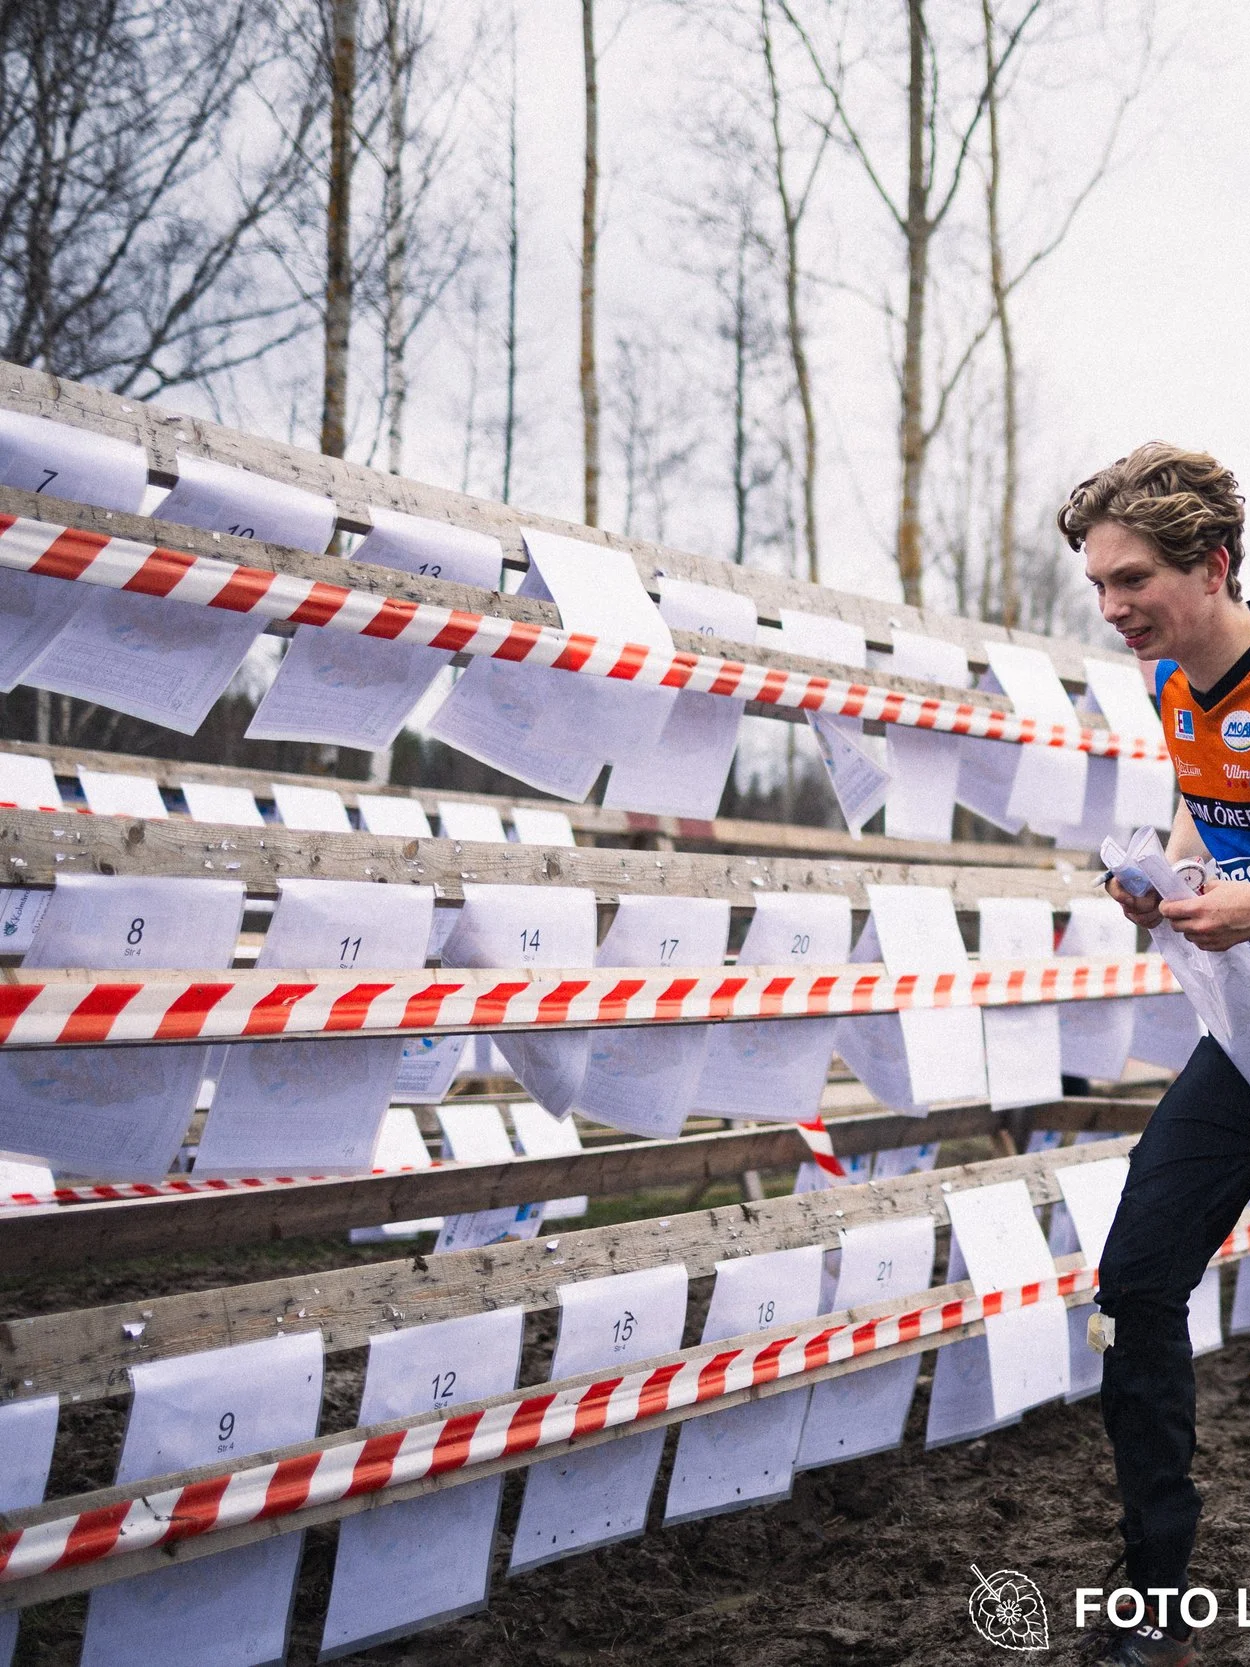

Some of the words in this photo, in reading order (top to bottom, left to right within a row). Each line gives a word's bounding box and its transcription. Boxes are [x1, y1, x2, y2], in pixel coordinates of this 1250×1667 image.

[36, 468, 59, 493] 7
[126, 917, 145, 945] 8
[520, 928, 541, 952] 14
[123, 948, 134, 957] Str
[135, 948, 142, 956] 4
[339, 936, 363, 961] 11
[659, 939, 680, 960] 17
[790, 934, 811, 955] 20
[876, 1260, 893, 1281] 21
[757, 1300, 776, 1324] 18
[612, 1317, 635, 1343] 15
[431, 1371, 457, 1400] 12
[218, 1411, 236, 1441] 9
[216, 1444, 228, 1454] Str
[228, 1441, 235, 1450] 4
